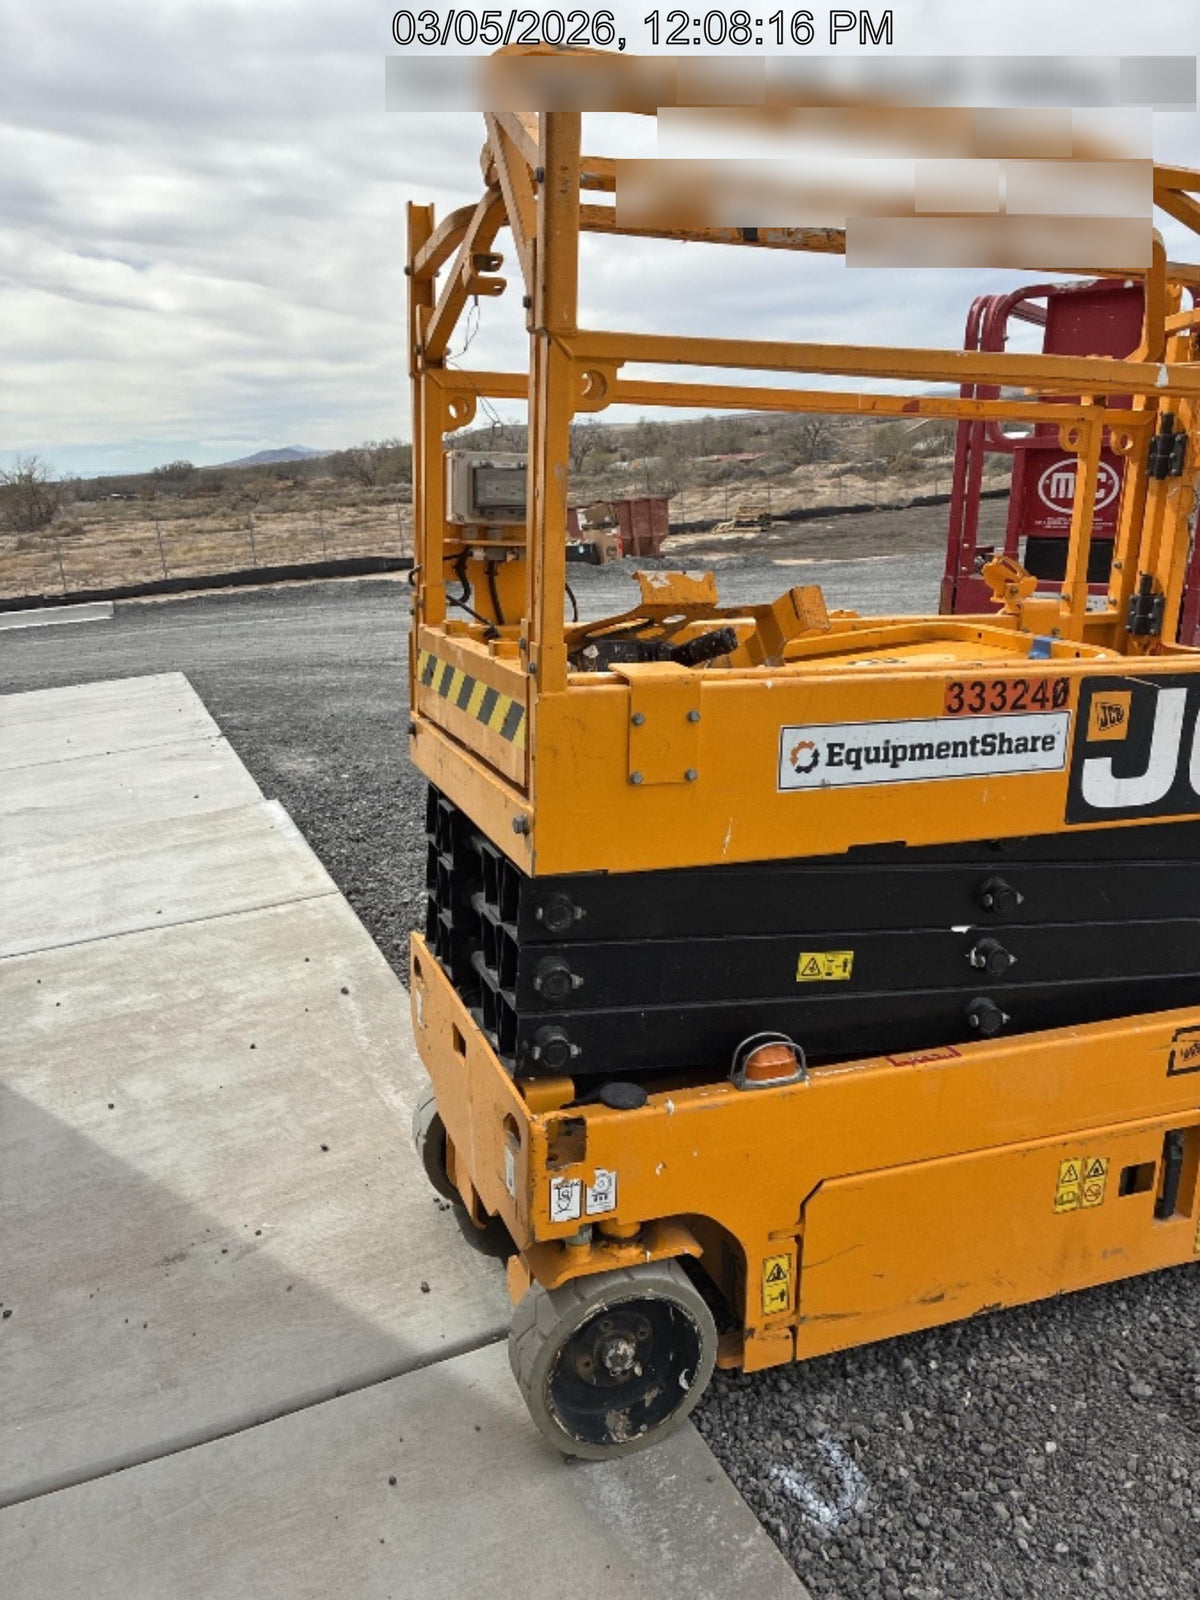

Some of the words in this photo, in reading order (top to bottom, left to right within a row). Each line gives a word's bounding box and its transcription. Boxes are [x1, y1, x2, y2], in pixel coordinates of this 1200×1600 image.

[1050, 472, 1107, 498] MC
[946, 677, 1071, 713] 333240
[825, 732, 1056, 771] EquipmentShare
